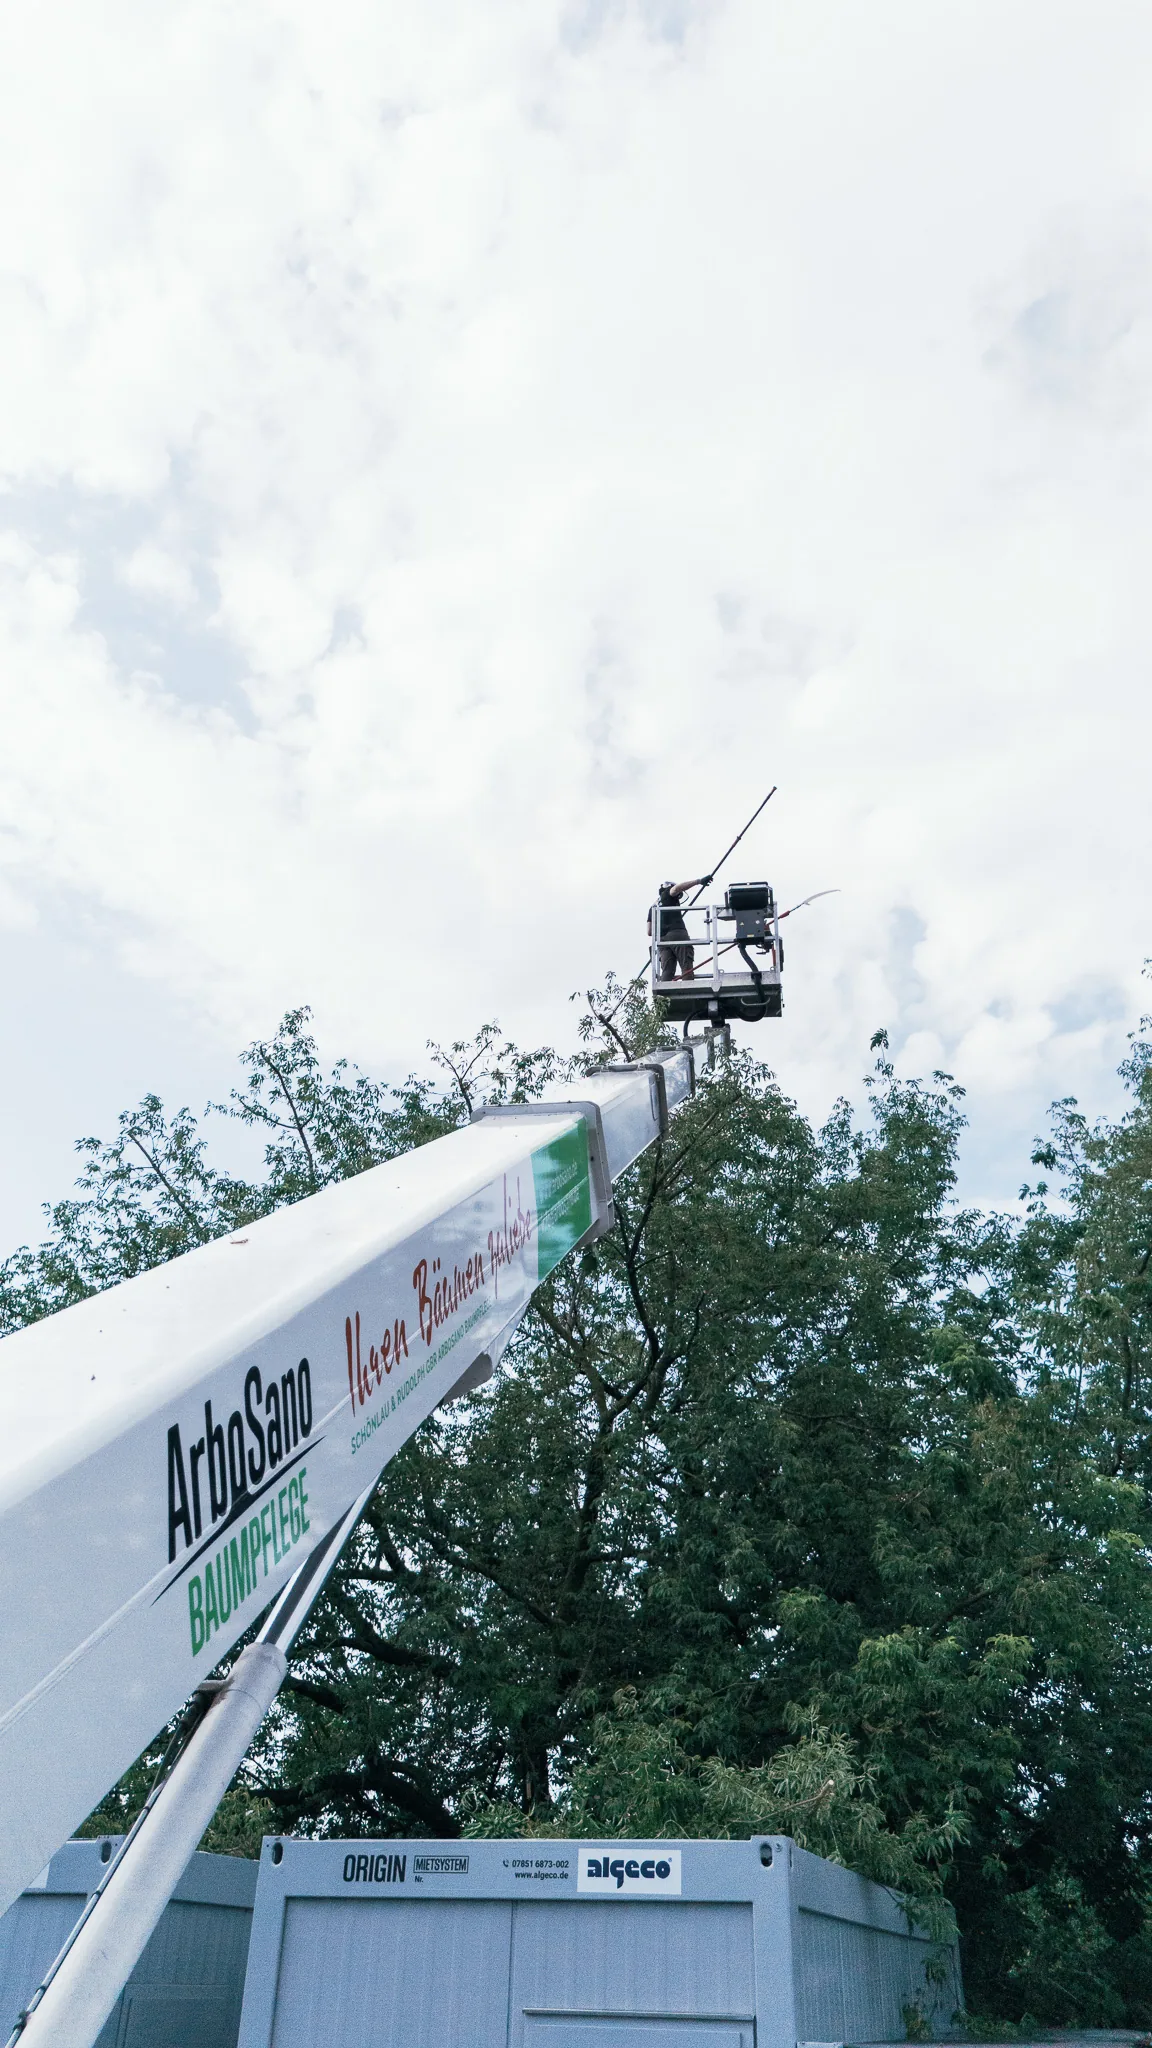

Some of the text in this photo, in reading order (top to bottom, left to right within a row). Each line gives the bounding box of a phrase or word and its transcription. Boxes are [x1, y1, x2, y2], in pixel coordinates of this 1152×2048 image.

[345, 1311, 408, 1417] Ihren
[413, 1252, 484, 1346] Bäumen
[351, 1400, 390, 1454] SCHÖNLAU
[391, 1395, 396, 1411] &
[397, 1363, 426, 1405] RUDOLPH
[167, 1357, 313, 1565] ArboSano
[188, 1467, 311, 1657] BAUMPFLEGE
[343, 1854, 467, 1883] ORIGIN MIETSYSTEM
[414, 1875, 424, 1883] Nr.
[512, 1859, 569, 1869] 07851 6873-002
[514, 1871, 569, 1880] www.algeco.de
